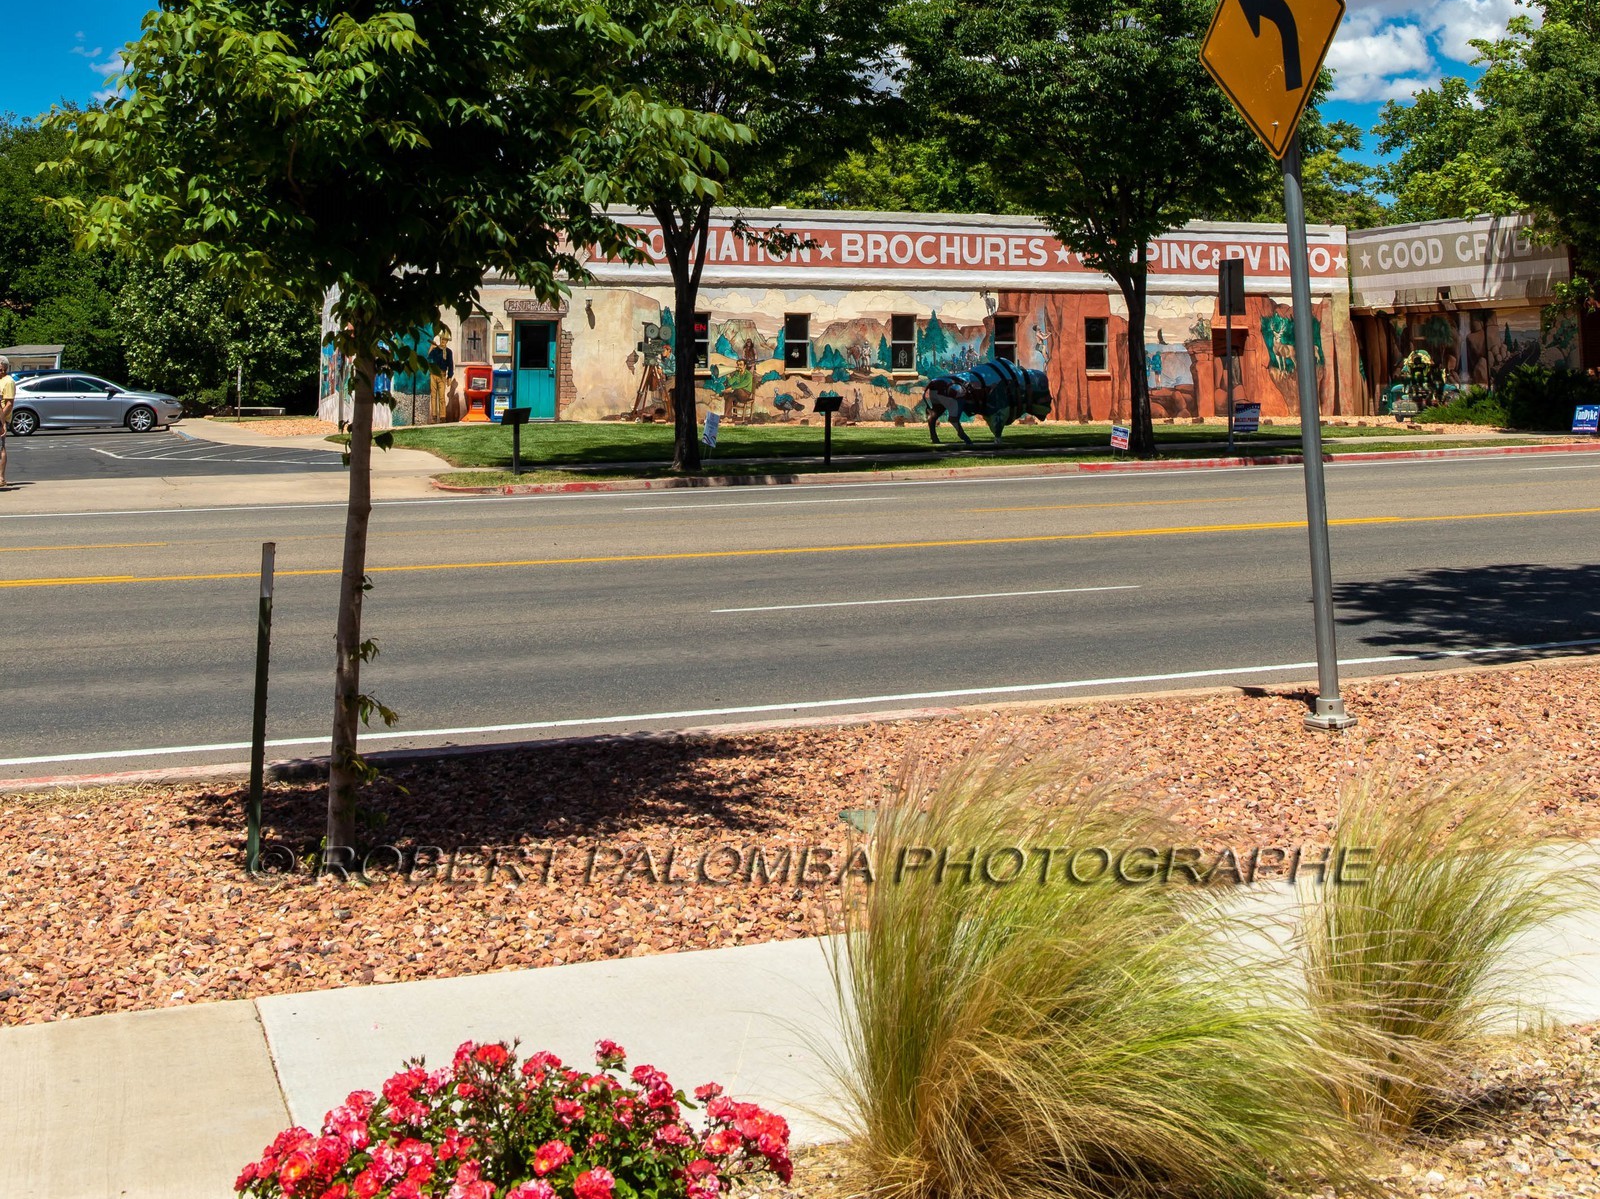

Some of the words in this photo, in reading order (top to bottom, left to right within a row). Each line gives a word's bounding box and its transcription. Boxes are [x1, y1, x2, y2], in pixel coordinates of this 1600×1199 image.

[595, 227, 811, 263] IOMATION
[841, 233, 1048, 266] BROCHURES
[1075, 240, 1211, 270] PING
[1269, 245, 1331, 273] INO
[1377, 238, 1444, 270] GOOD
[1455, 231, 1533, 263] GRUB
[508, 301, 567, 313] ENTRANE
[693, 323, 707, 332] EN
